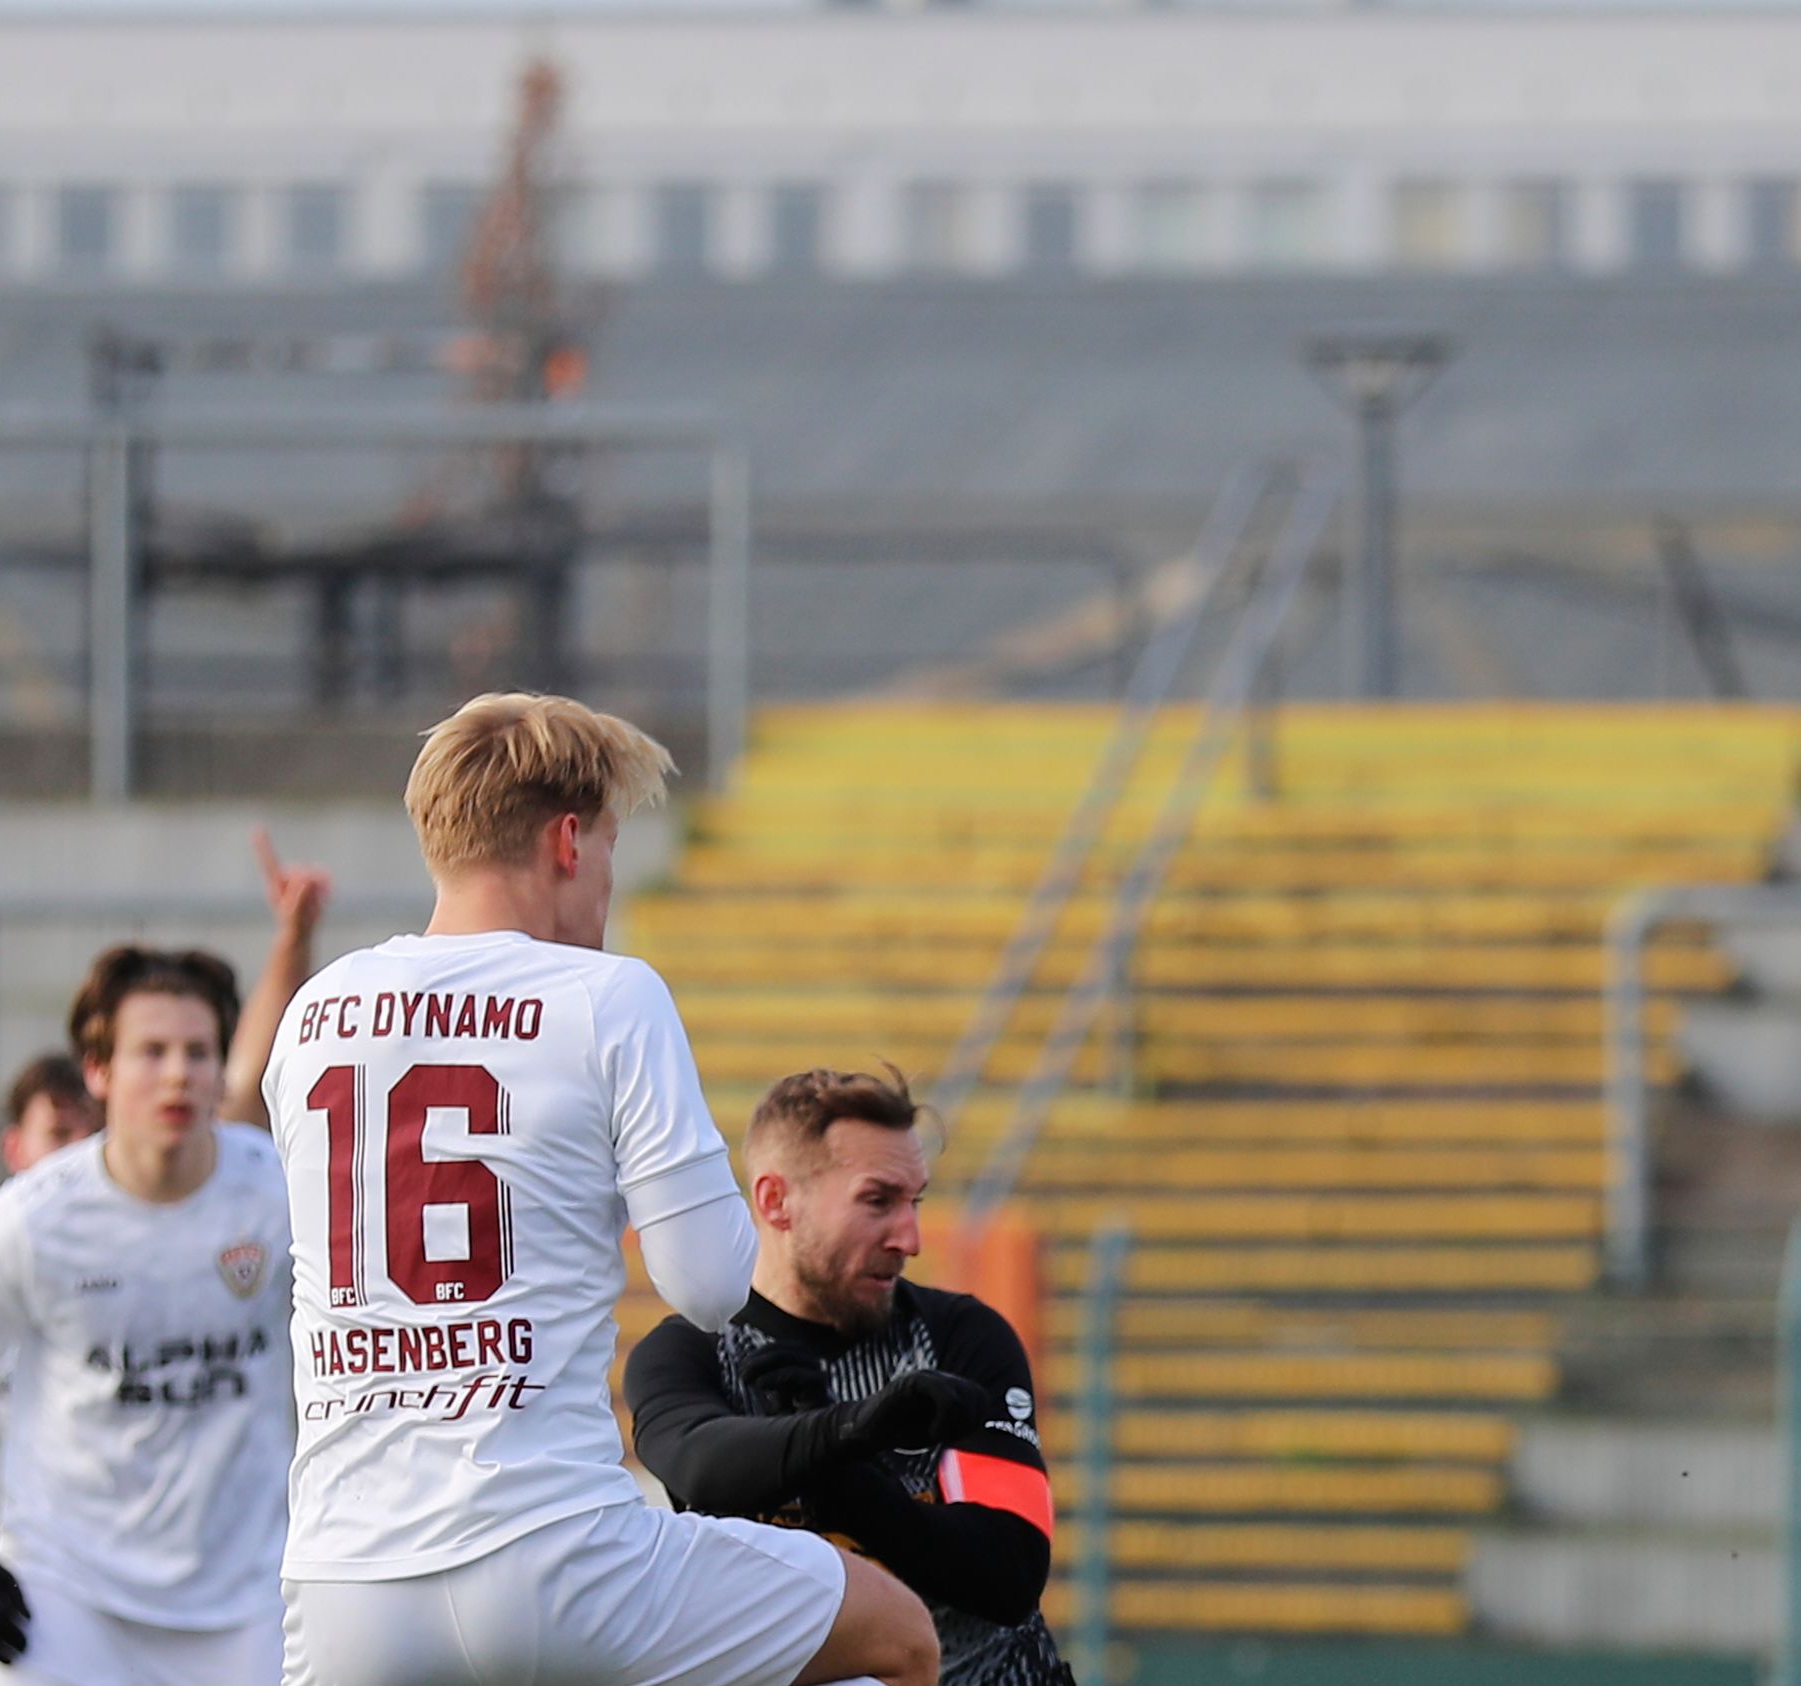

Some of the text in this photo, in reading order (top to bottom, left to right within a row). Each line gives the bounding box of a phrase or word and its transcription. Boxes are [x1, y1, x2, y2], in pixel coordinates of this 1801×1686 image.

[298, 991, 544, 1046] BFC DYNAMO
[306, 1063, 514, 1307] 16
[331, 1287, 356, 1305] BFC
[435, 1282, 465, 1300] BFC
[309, 1318, 533, 1378] HASENBERG
